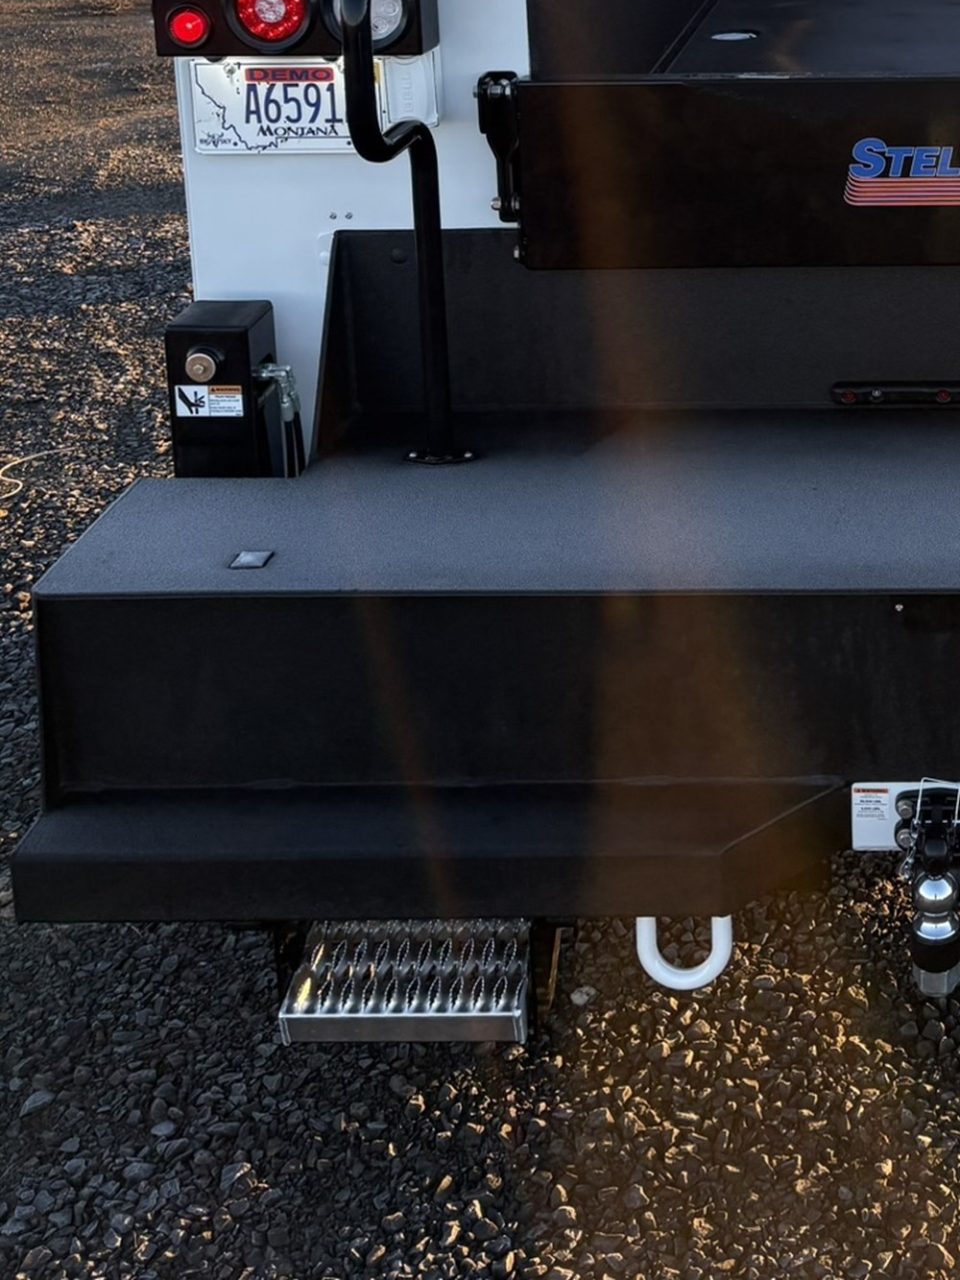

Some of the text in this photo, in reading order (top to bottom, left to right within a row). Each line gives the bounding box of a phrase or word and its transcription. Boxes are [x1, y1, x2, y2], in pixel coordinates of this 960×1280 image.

[249, 69, 331, 81] DEMO
[245, 83, 343, 124] A6591
[257, 124, 339, 137] MONTANA
